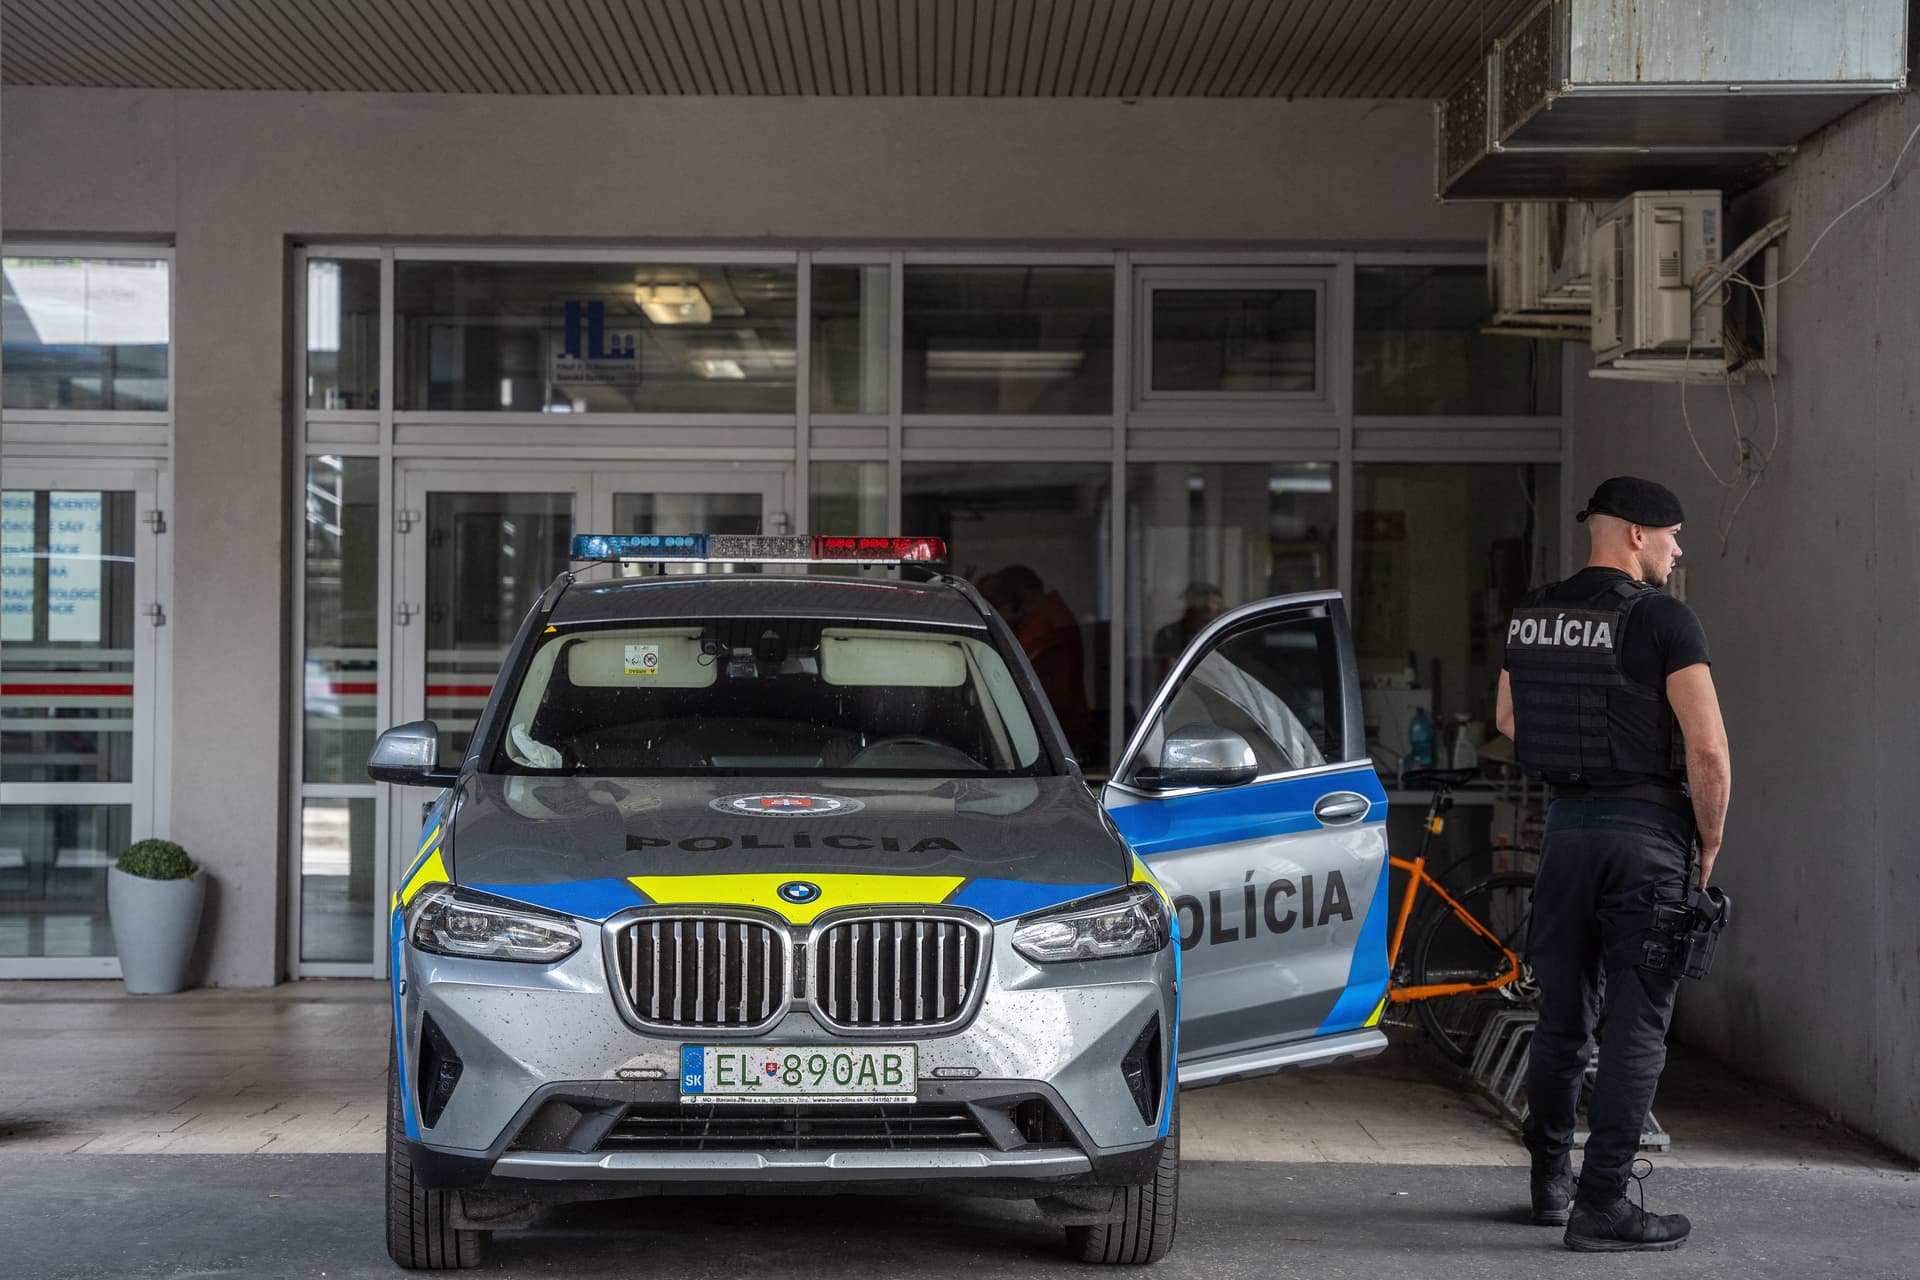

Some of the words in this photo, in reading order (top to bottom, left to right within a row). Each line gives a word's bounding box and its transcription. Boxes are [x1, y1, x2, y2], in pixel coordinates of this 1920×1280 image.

[1507, 613, 1613, 648] POLÍCIA
[625, 831, 963, 852] POLÍCIA
[1173, 869, 1354, 951] OLÍCIA
[685, 1074, 702, 1087] SK
[716, 1054, 760, 1086] EL
[782, 1053, 903, 1086] 890AB
